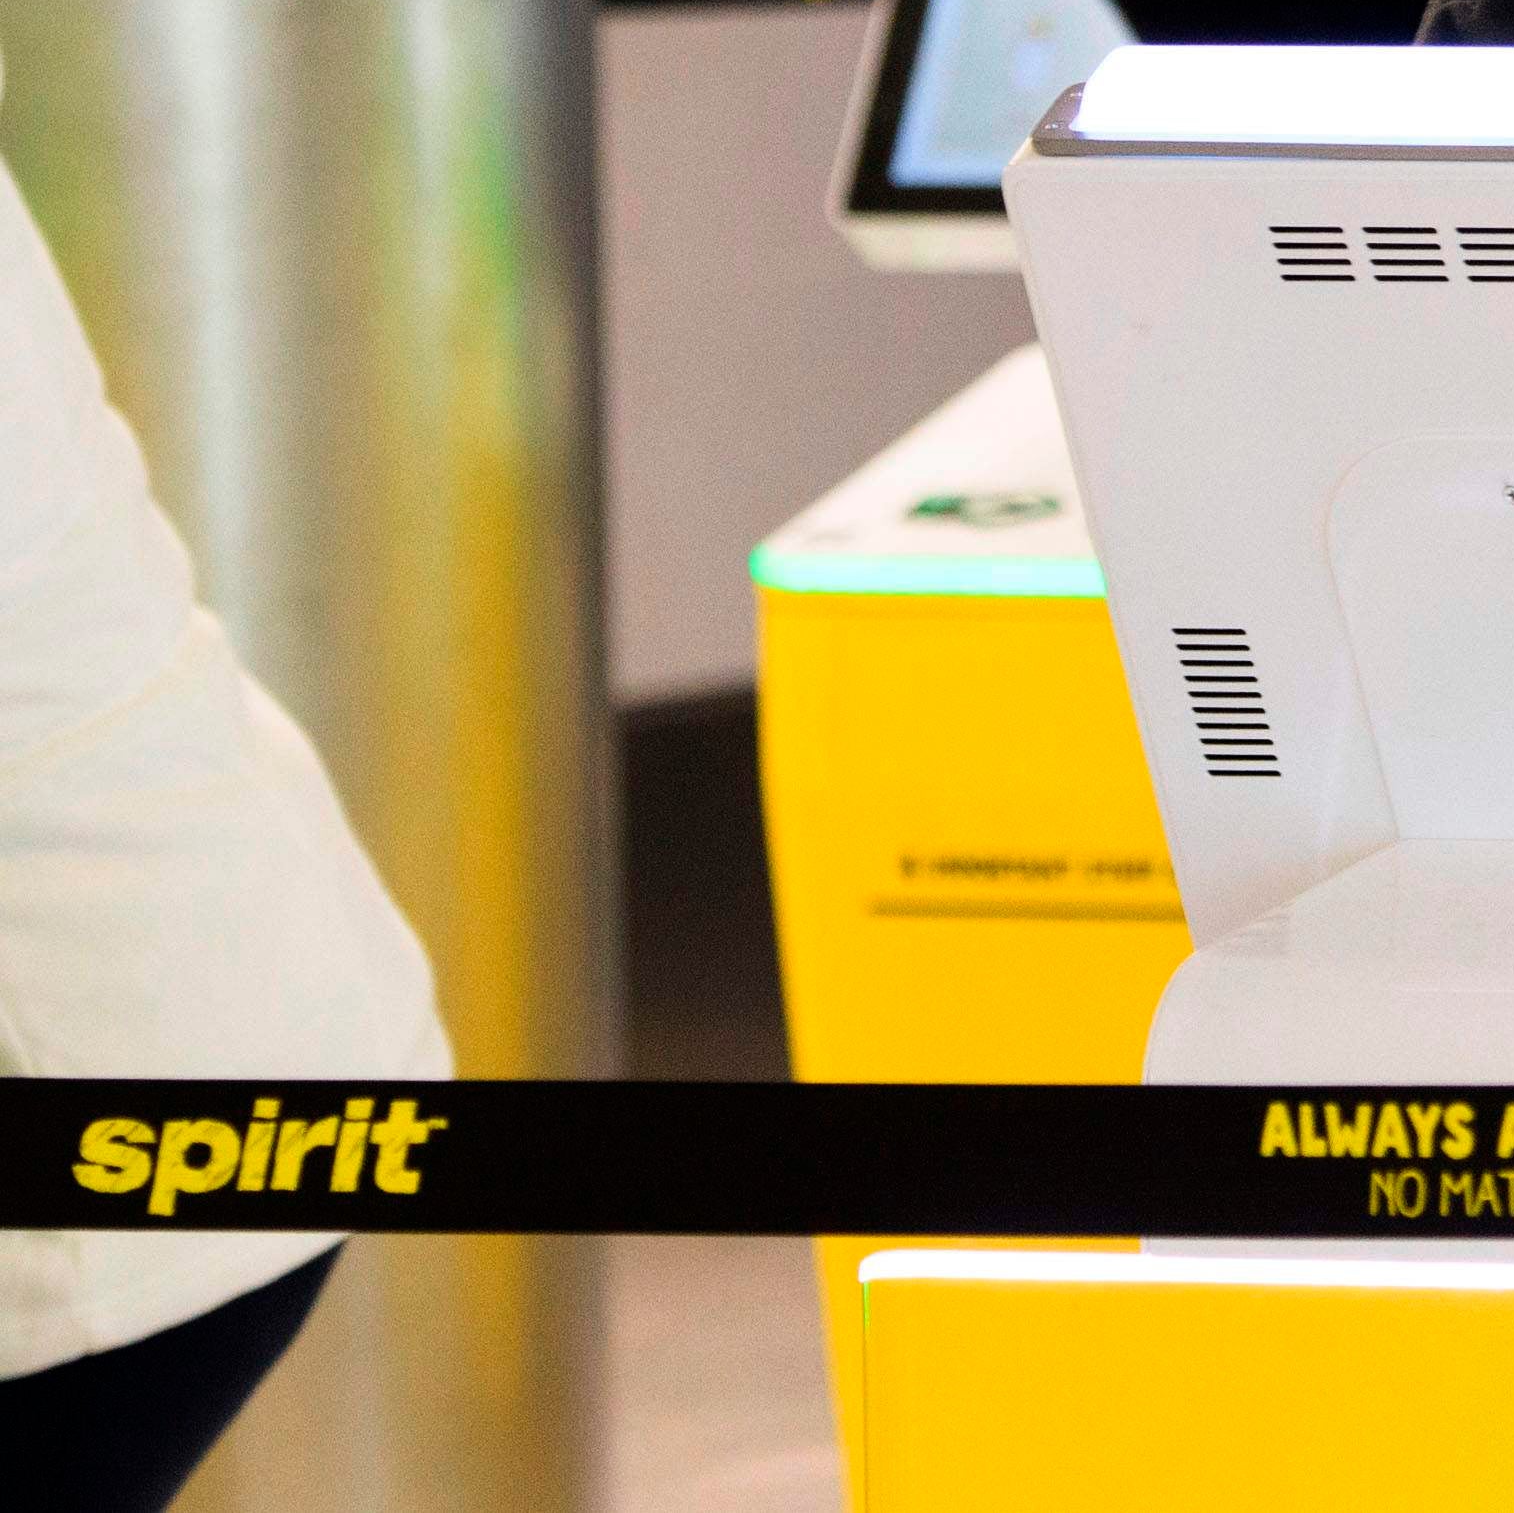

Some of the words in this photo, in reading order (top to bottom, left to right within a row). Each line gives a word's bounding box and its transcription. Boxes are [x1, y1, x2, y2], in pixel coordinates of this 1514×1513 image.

[72, 1098, 430, 1217] spirit
[1259, 1102, 1475, 1160] ALWAYS
[1369, 1169, 1427, 1219] NO
